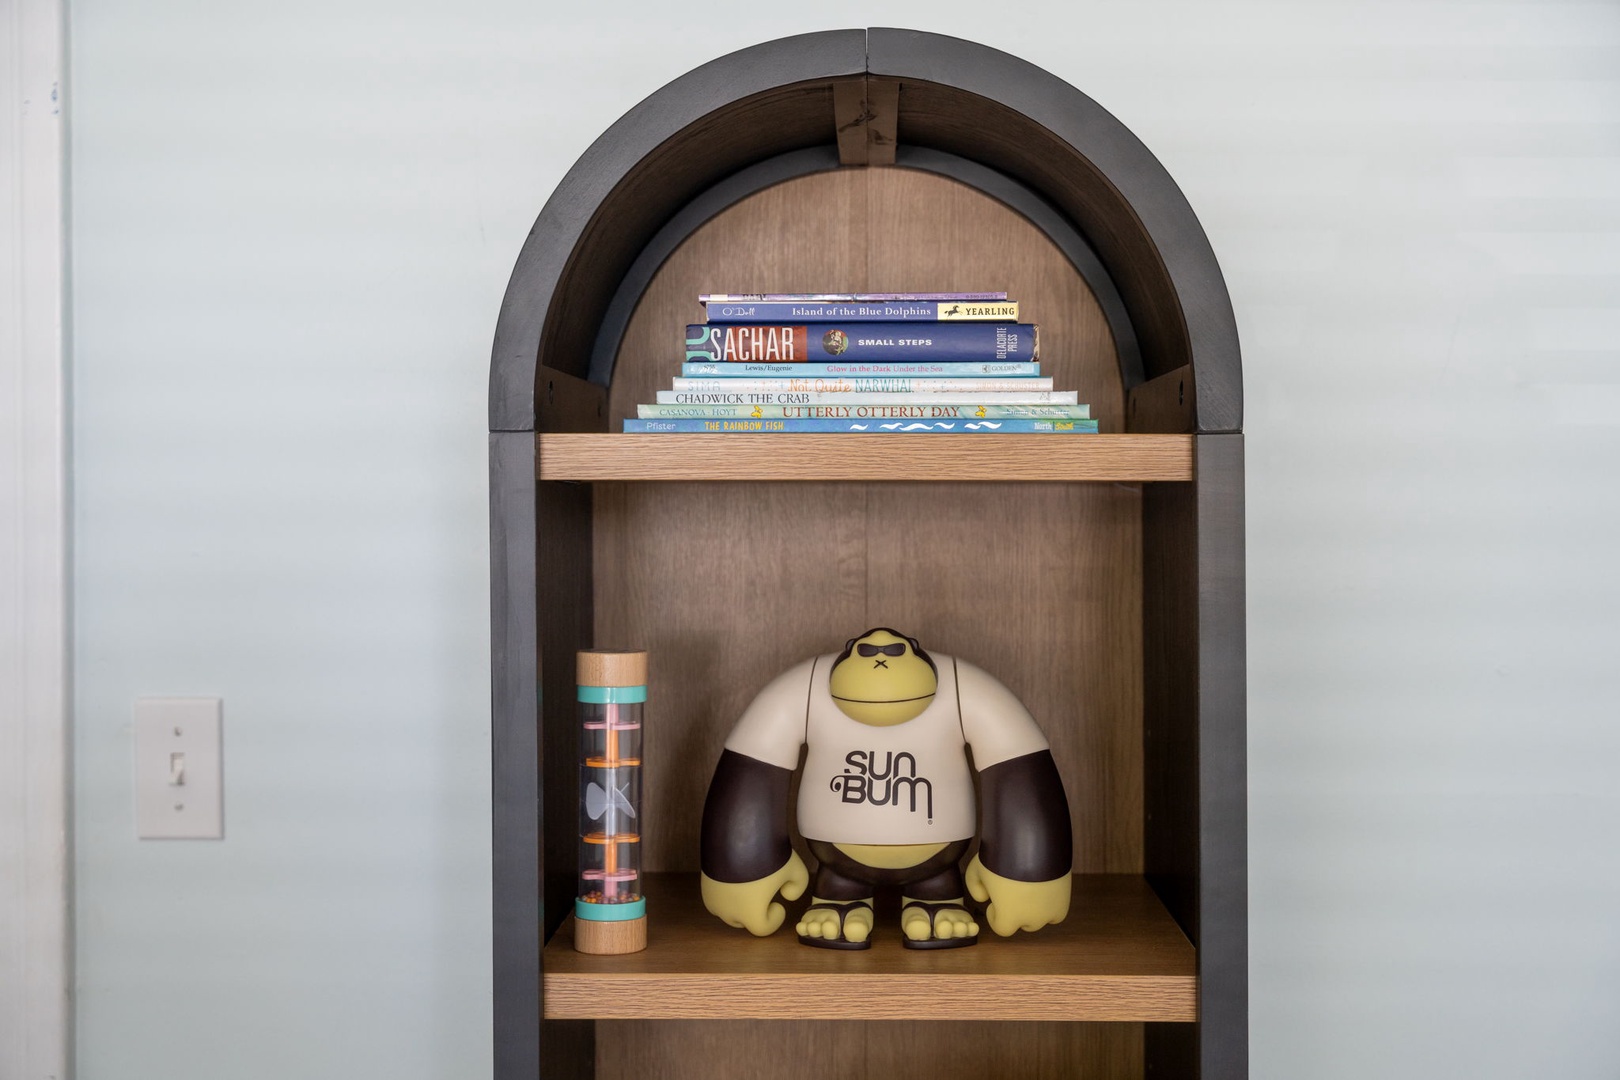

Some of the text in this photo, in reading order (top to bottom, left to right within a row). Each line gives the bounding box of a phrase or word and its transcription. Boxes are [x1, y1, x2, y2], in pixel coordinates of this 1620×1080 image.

[792, 307, 931, 318] Island of the Blue Dolphins
[966, 307, 1015, 316] YEARLING
[710, 327, 794, 361] SACHAR
[996, 327, 1007, 359] DELACORTE
[1007, 334, 1018, 352] PRESS
[745, 364, 792, 372] Lewis/Eugenie
[826, 365, 847, 373] Glow
[688, 381, 721, 391] SIMA
[788, 378, 812, 392] Not
[814, 378, 851, 393] Quite
[675, 394, 810, 404] CHADWICK THE CRAB
[659, 408, 738, 416] CASANOVA HOYT
[783, 406, 960, 417] UTTERLY OTTERLY DAY
[646, 422, 676, 430] Pfister
[704, 421, 785, 430] THE RAINBOW FISH
[1034, 422, 1053, 430] North
